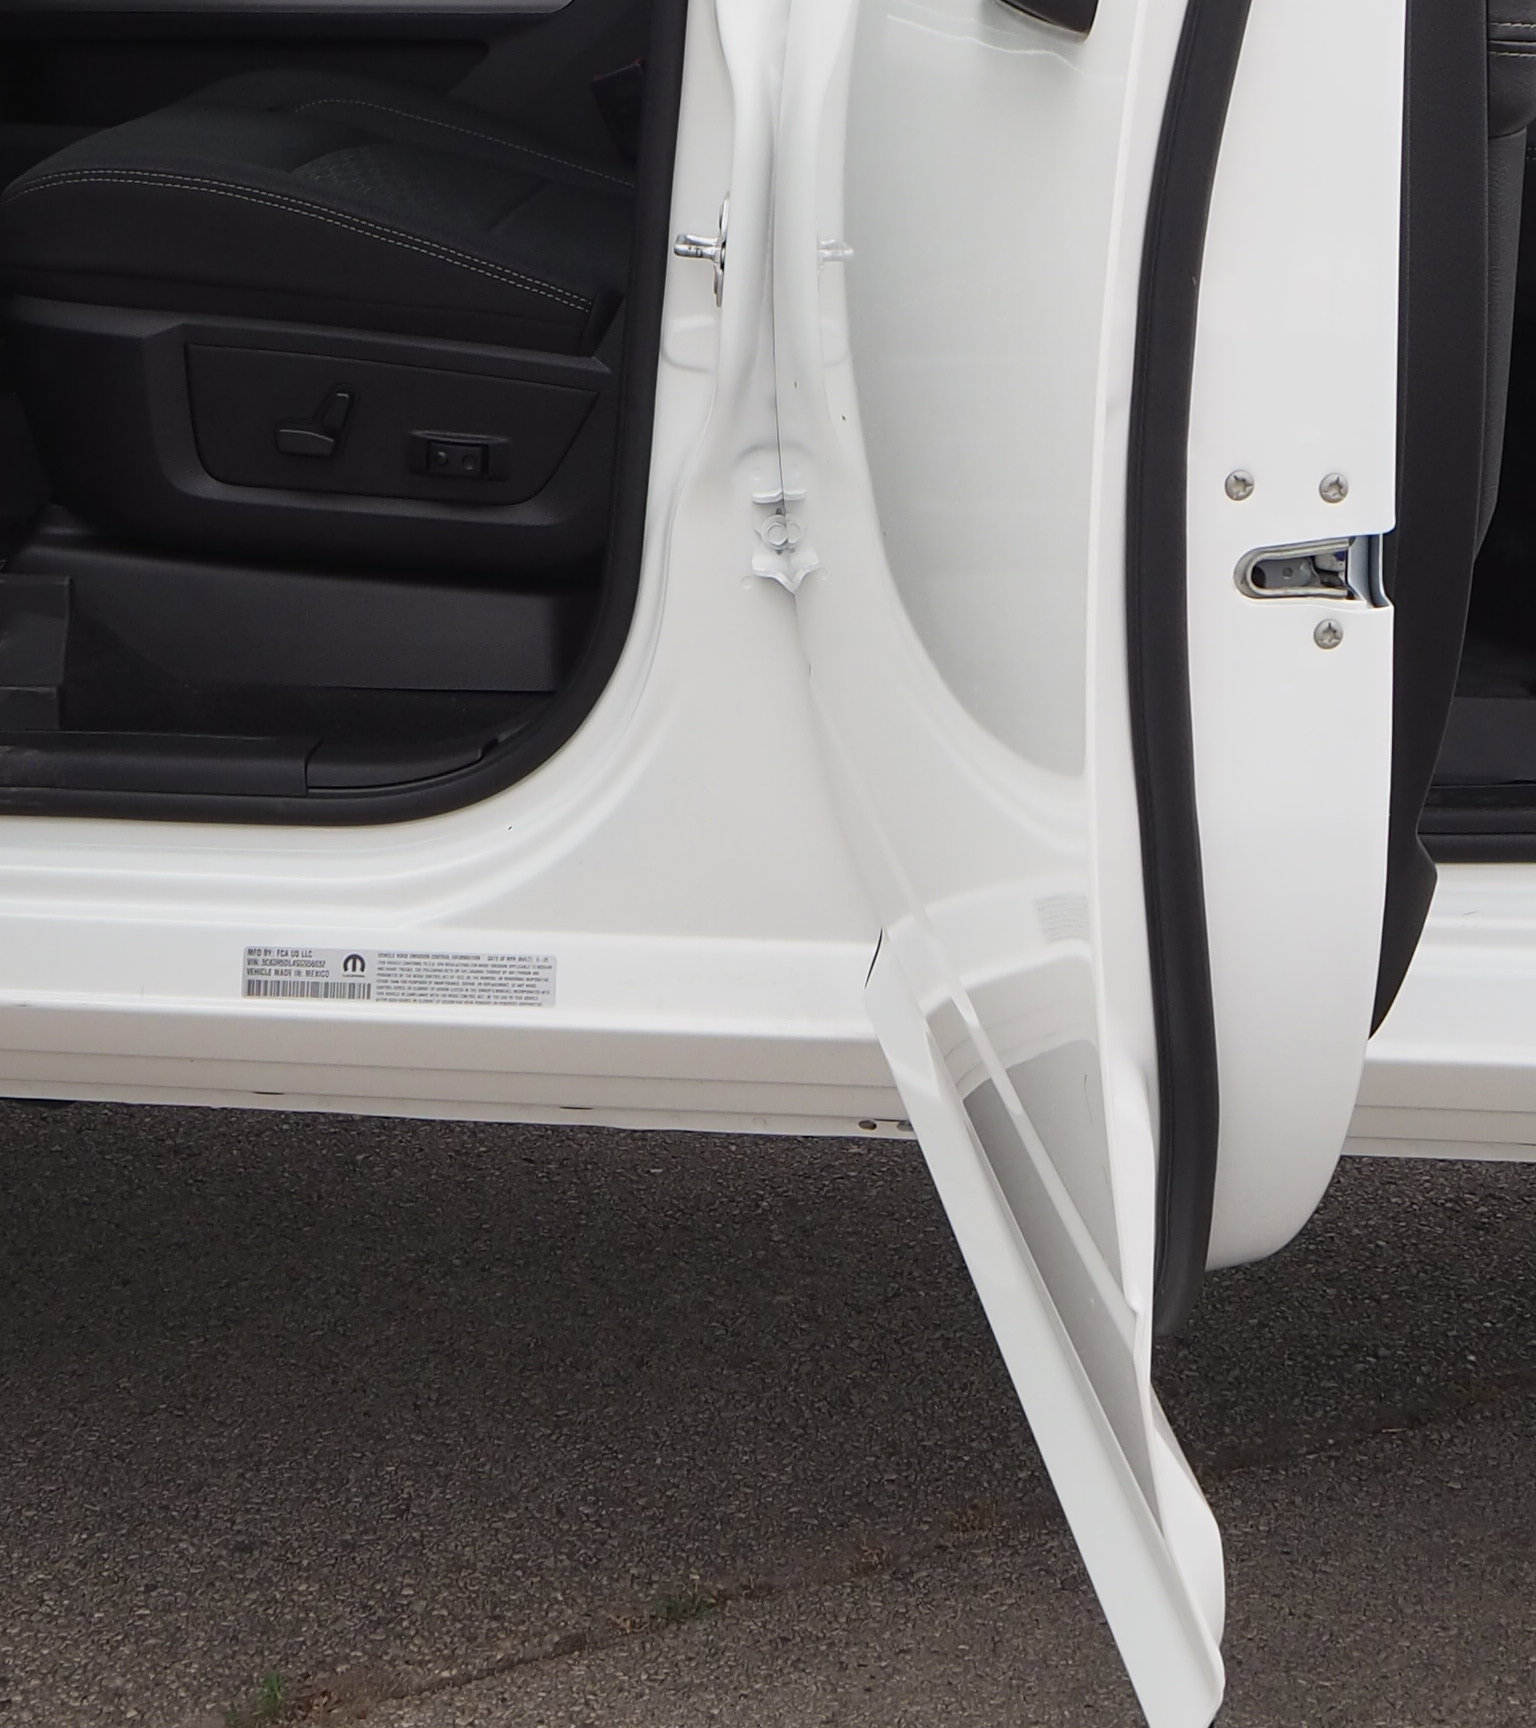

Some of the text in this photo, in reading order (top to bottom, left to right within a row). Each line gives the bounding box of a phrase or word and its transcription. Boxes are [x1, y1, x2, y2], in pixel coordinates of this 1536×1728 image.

[277, 949, 288, 957] FCA
[301, 950, 312, 958] LLC
[247, 967, 271, 976] VEHICLE
[274, 968, 291, 977] MADE
[305, 969, 329, 978] MEXICO
